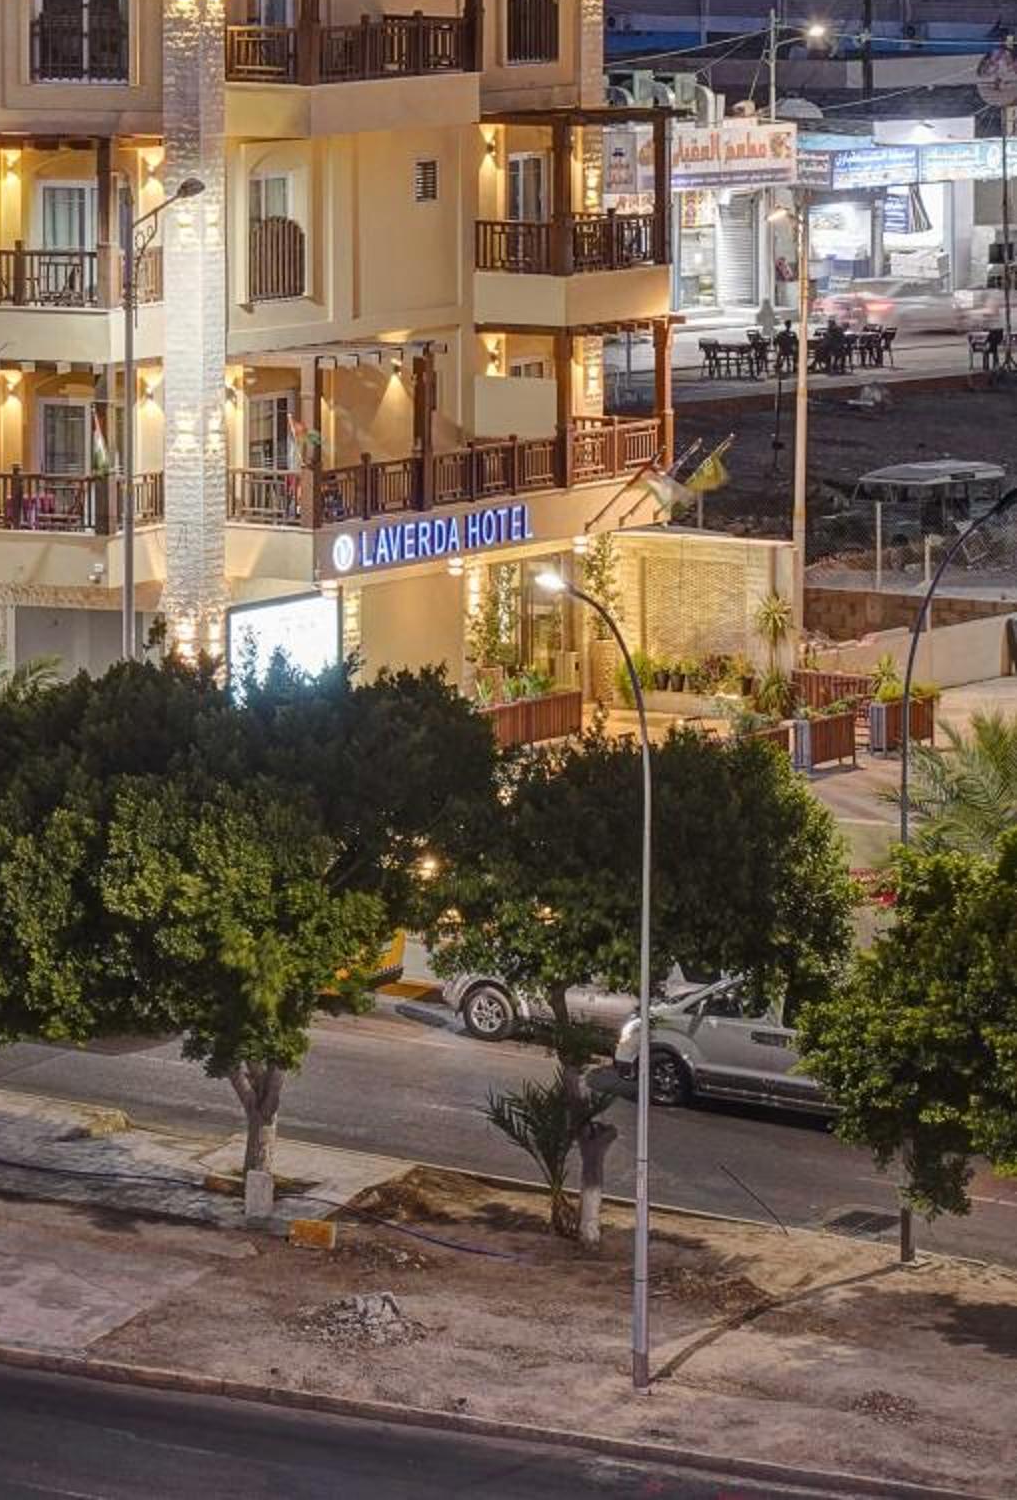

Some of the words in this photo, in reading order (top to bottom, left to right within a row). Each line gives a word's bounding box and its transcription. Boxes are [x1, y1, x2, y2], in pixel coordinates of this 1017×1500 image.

[725, 131, 766, 164] مطعم
[360, 516, 460, 567] LAVERDA
[465, 504, 533, 549] HOTEL
